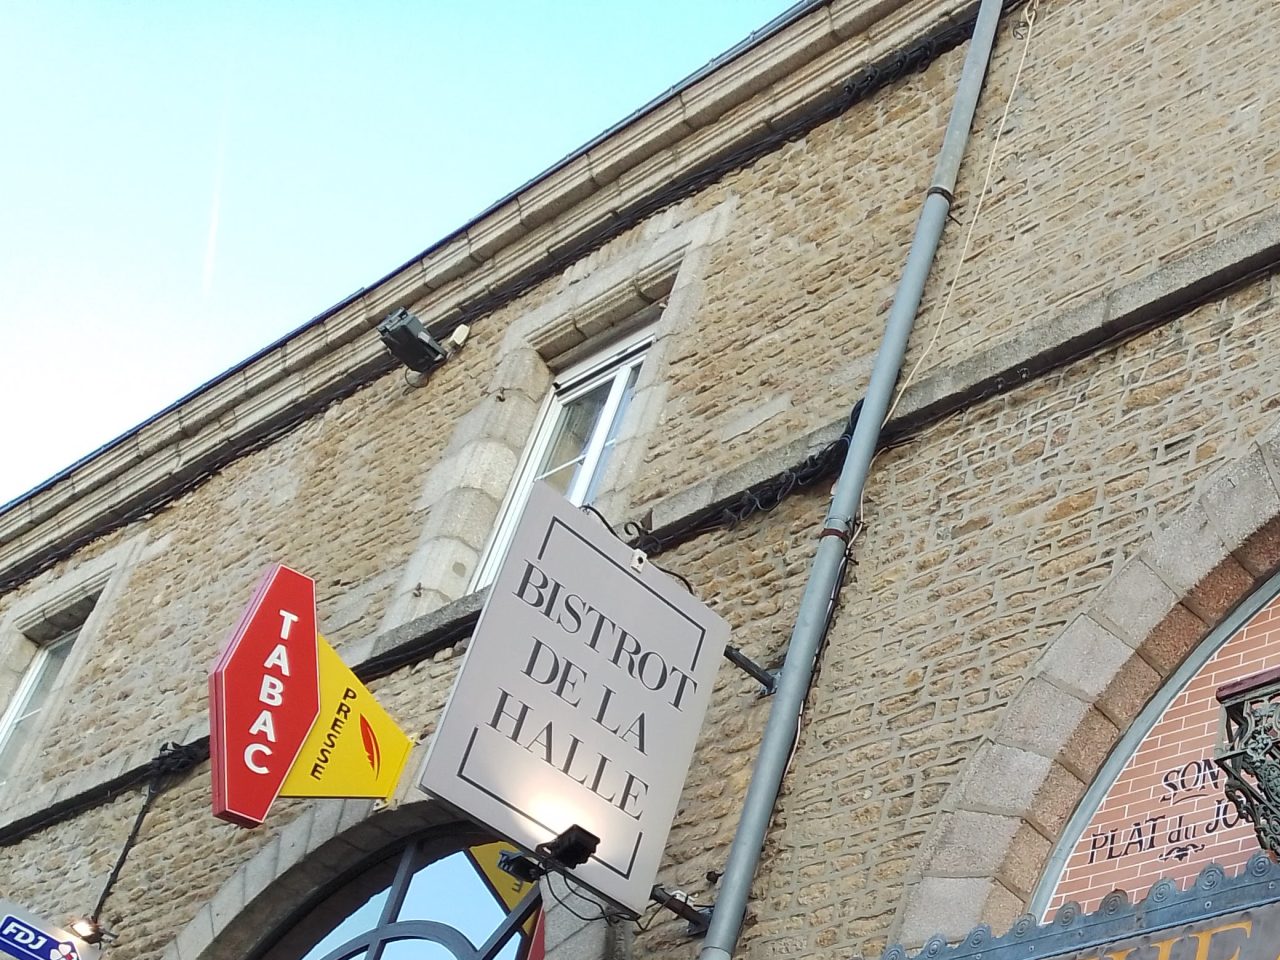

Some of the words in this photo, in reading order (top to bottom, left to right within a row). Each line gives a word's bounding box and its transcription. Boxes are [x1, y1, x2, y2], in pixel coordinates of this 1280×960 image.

[512, 558, 698, 713] BISTROT
[243, 609, 299, 775] TABAC
[310, 686, 357, 782] PRESSE
[520, 636, 588, 709] DE
[591, 684, 649, 757] LA
[484, 686, 650, 822] HALLE
[1160, 759, 1221, 803] SON
[1087, 815, 1166, 865] PLAT
[1167, 815, 1198, 845] du
[2, 921, 48, 950] FDJ
